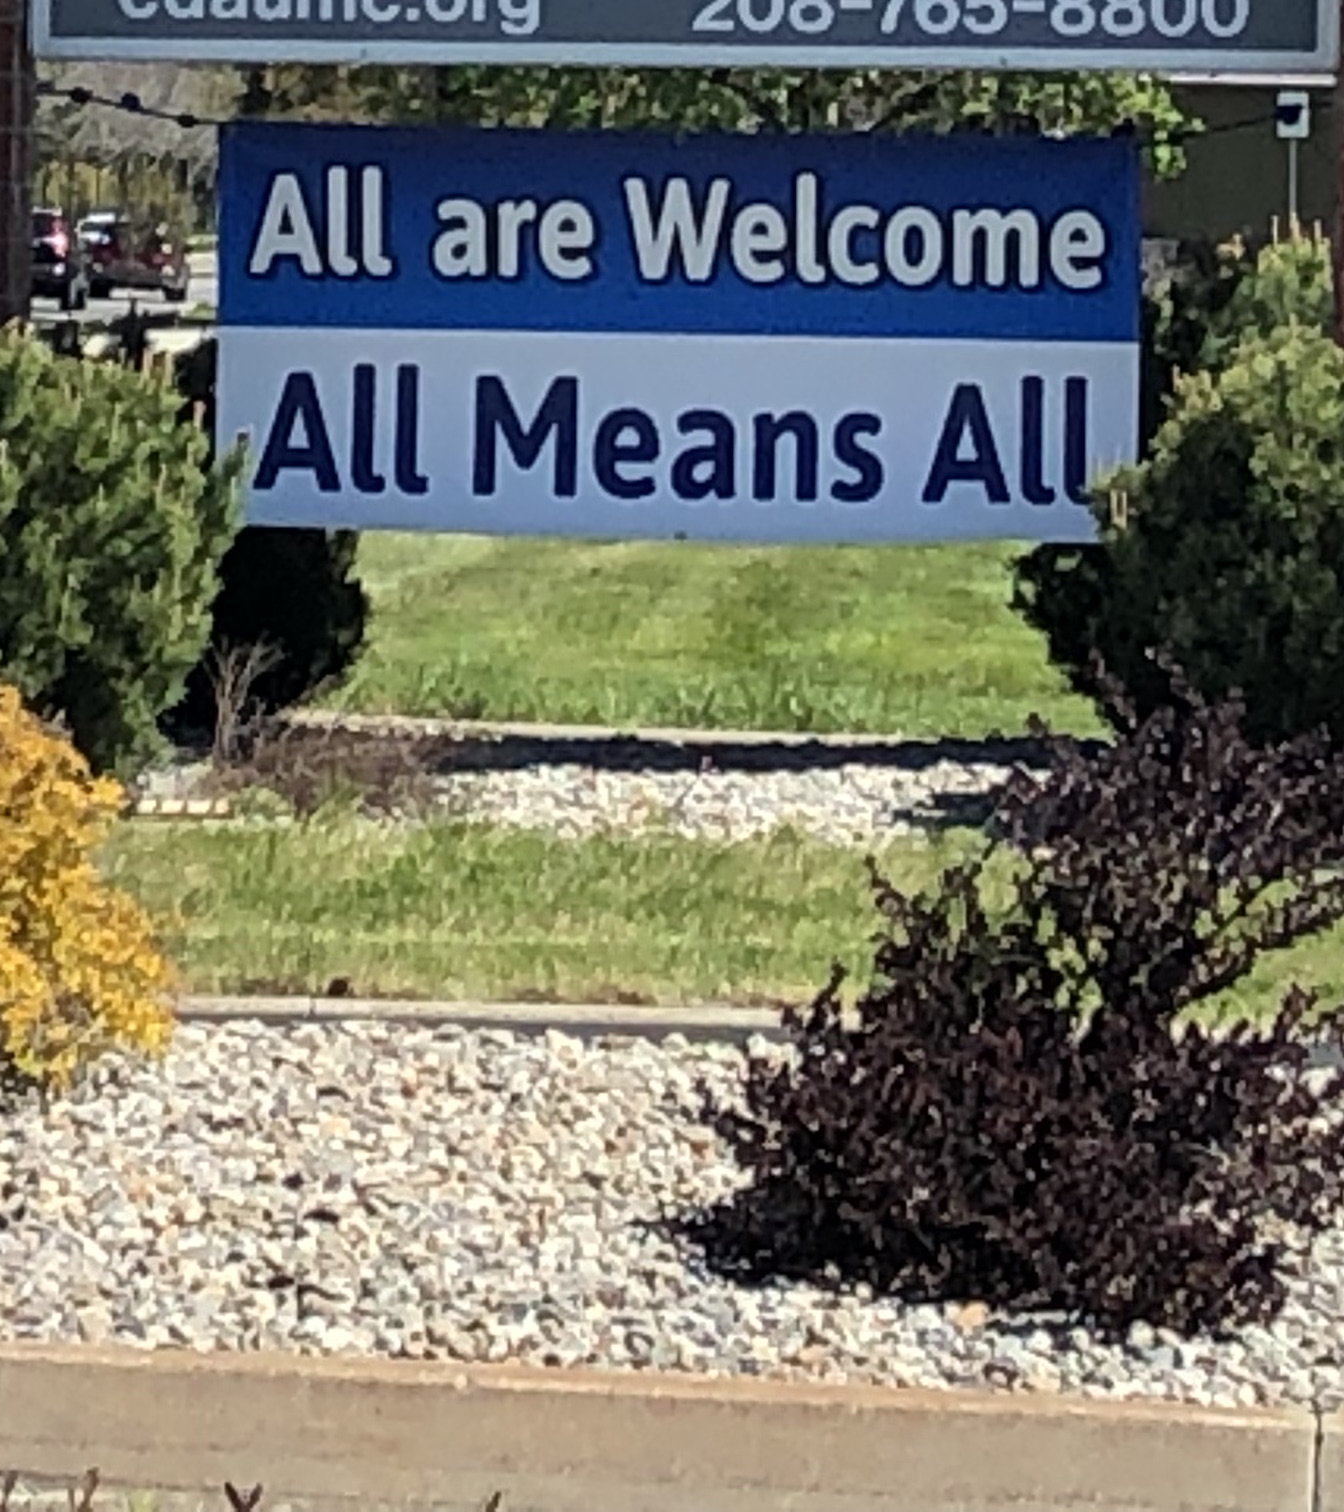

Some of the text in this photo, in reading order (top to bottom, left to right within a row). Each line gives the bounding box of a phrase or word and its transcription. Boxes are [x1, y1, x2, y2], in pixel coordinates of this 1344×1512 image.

[250, 165, 1105, 289] All are Welcome
[252, 363, 1092, 507] All Means All
